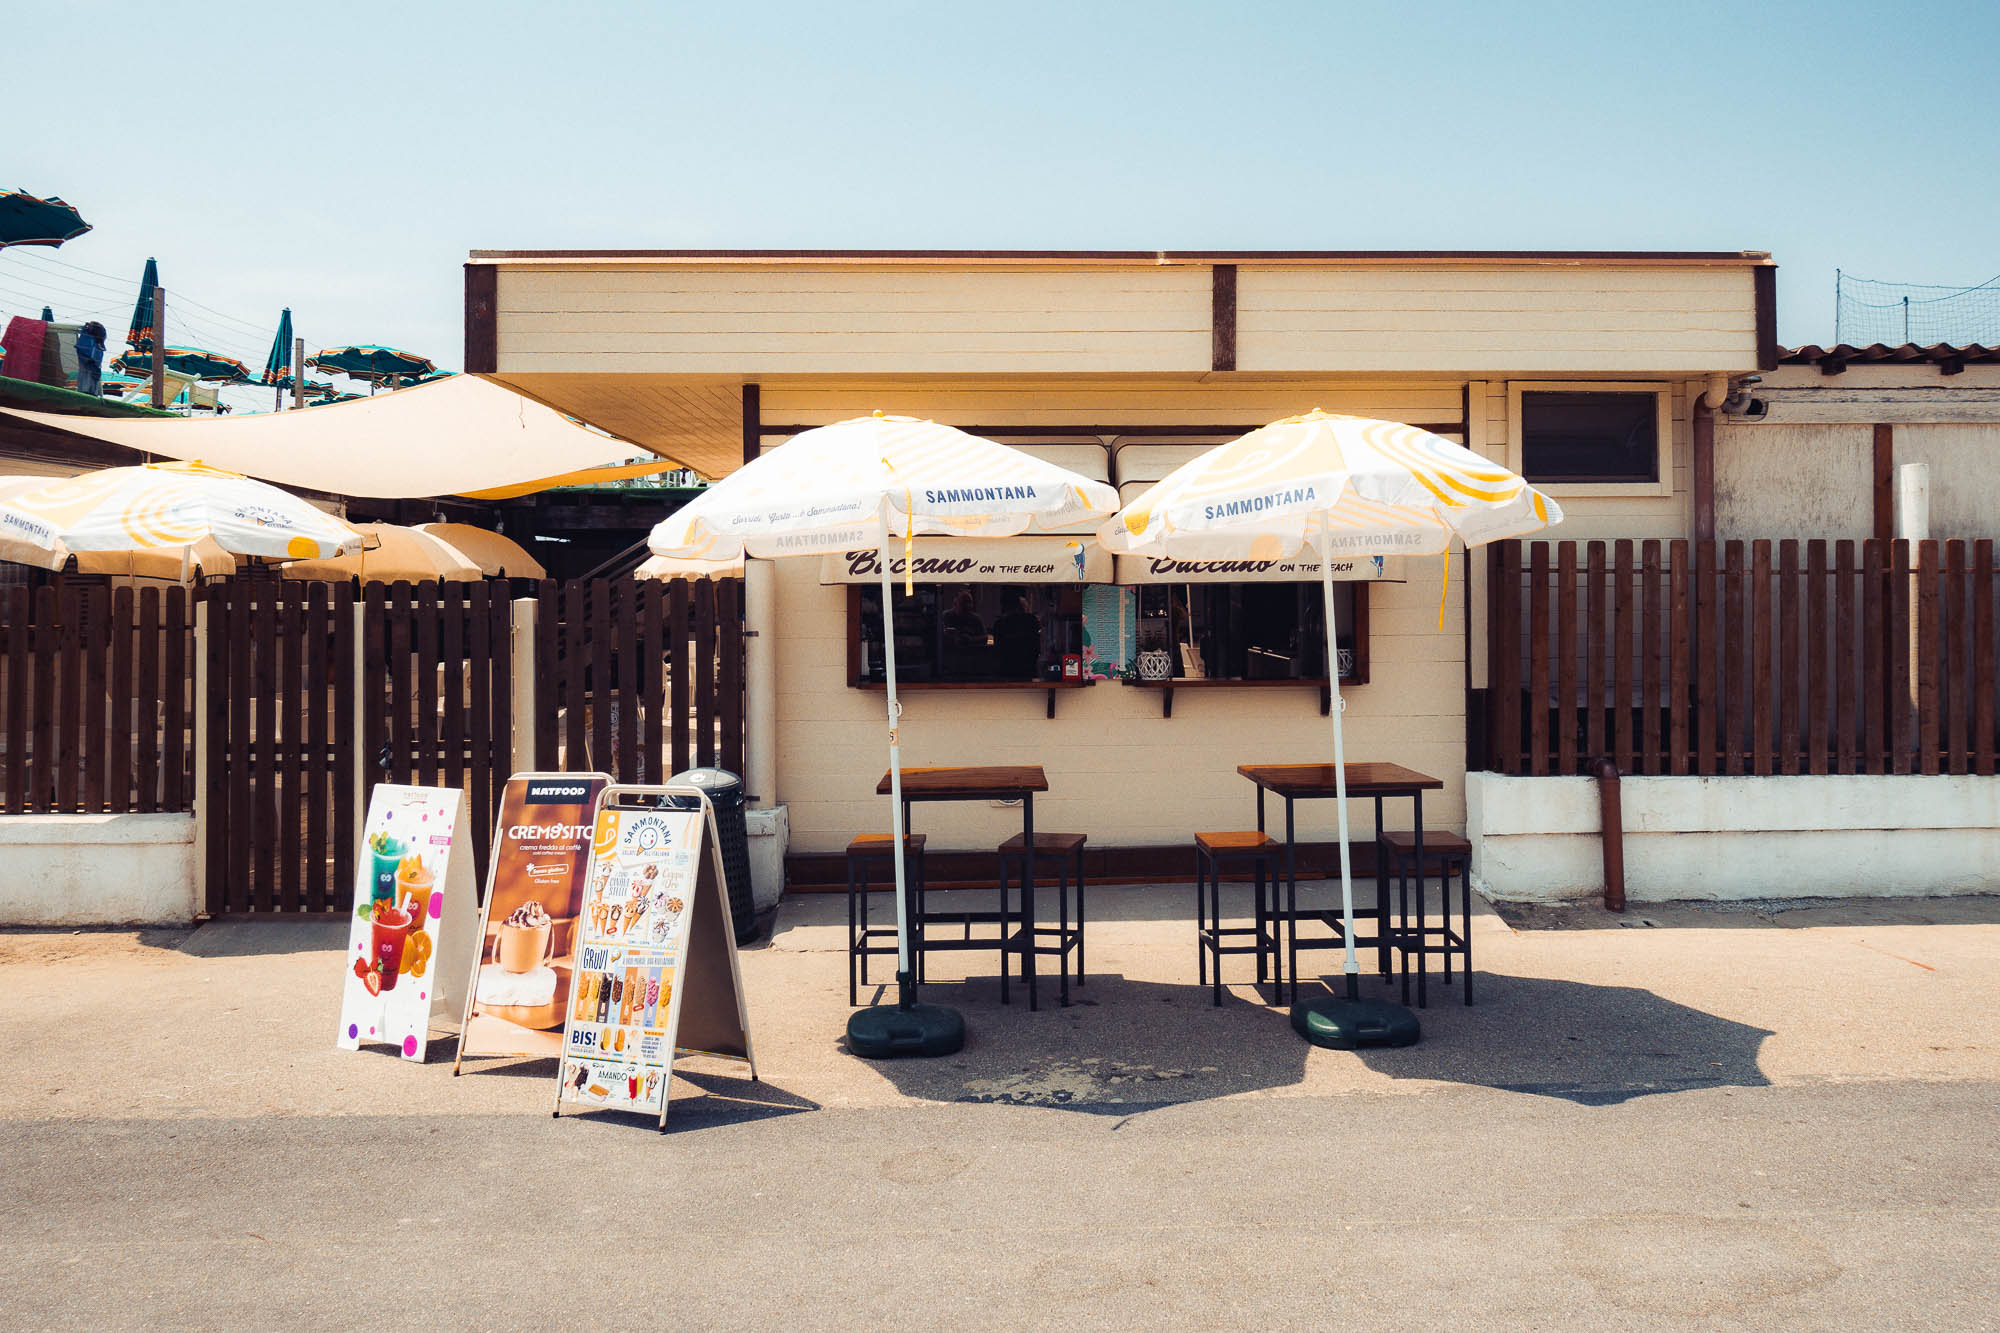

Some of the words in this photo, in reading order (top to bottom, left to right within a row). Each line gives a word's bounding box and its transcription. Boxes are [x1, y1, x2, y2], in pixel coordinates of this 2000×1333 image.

[926, 485, 1036, 504] SAMMONTANA
[1205, 487, 1315, 520] SAMMONTANA
[979, 565, 995, 574] ON
[999, 565, 1021, 574] THE
[1023, 564, 1055, 574] BEACH
[1280, 563, 1295, 572] ON
[1299, 564, 1321, 572] THE
[1330, 562, 1354, 572] EACH
[531, 787, 586, 796] NATFOOD
[624, 816, 672, 845] SAMMONTANA
[571, 1030, 597, 1046] BIS!
[597, 1070, 628, 1081] AMANDO
